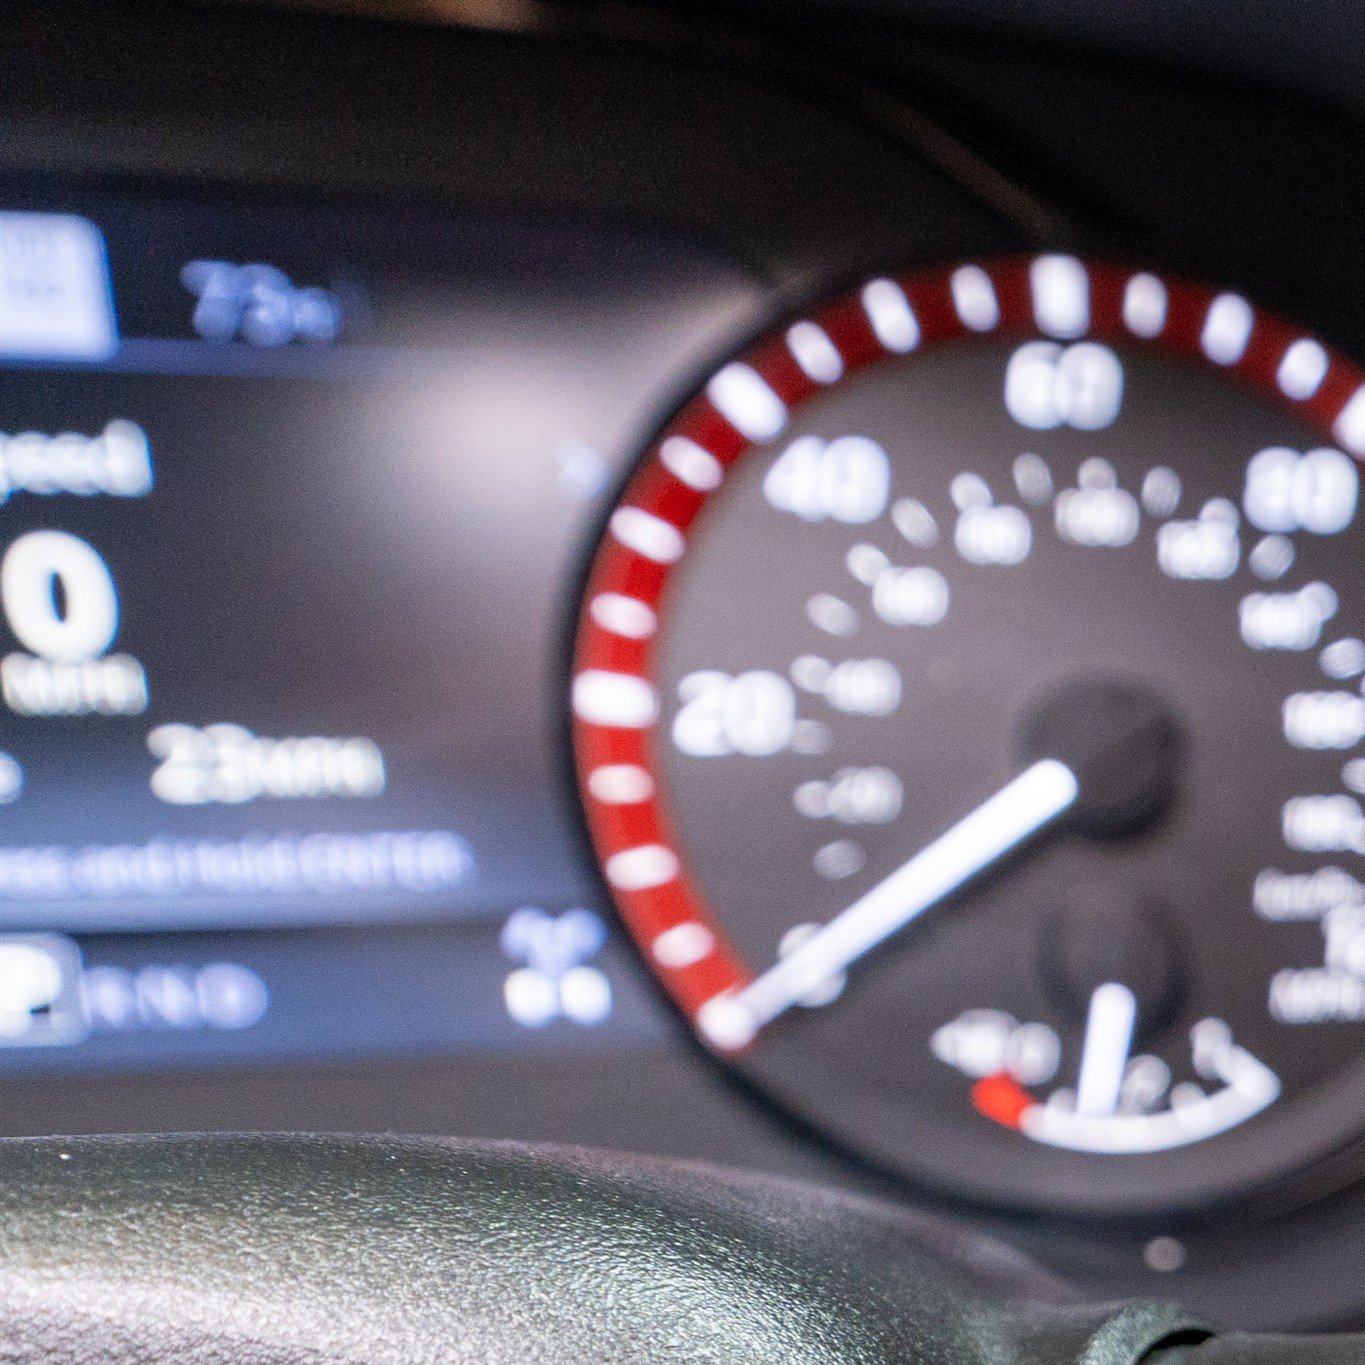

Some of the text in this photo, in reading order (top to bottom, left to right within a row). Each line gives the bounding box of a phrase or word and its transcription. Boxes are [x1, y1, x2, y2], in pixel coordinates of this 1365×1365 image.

[1005, 341, 1123, 429] 60
[763, 435, 890, 524] 40
[1245, 447, 1358, 534] 80
[2, 530, 119, 662] 0
[671, 670, 794, 756] 20
